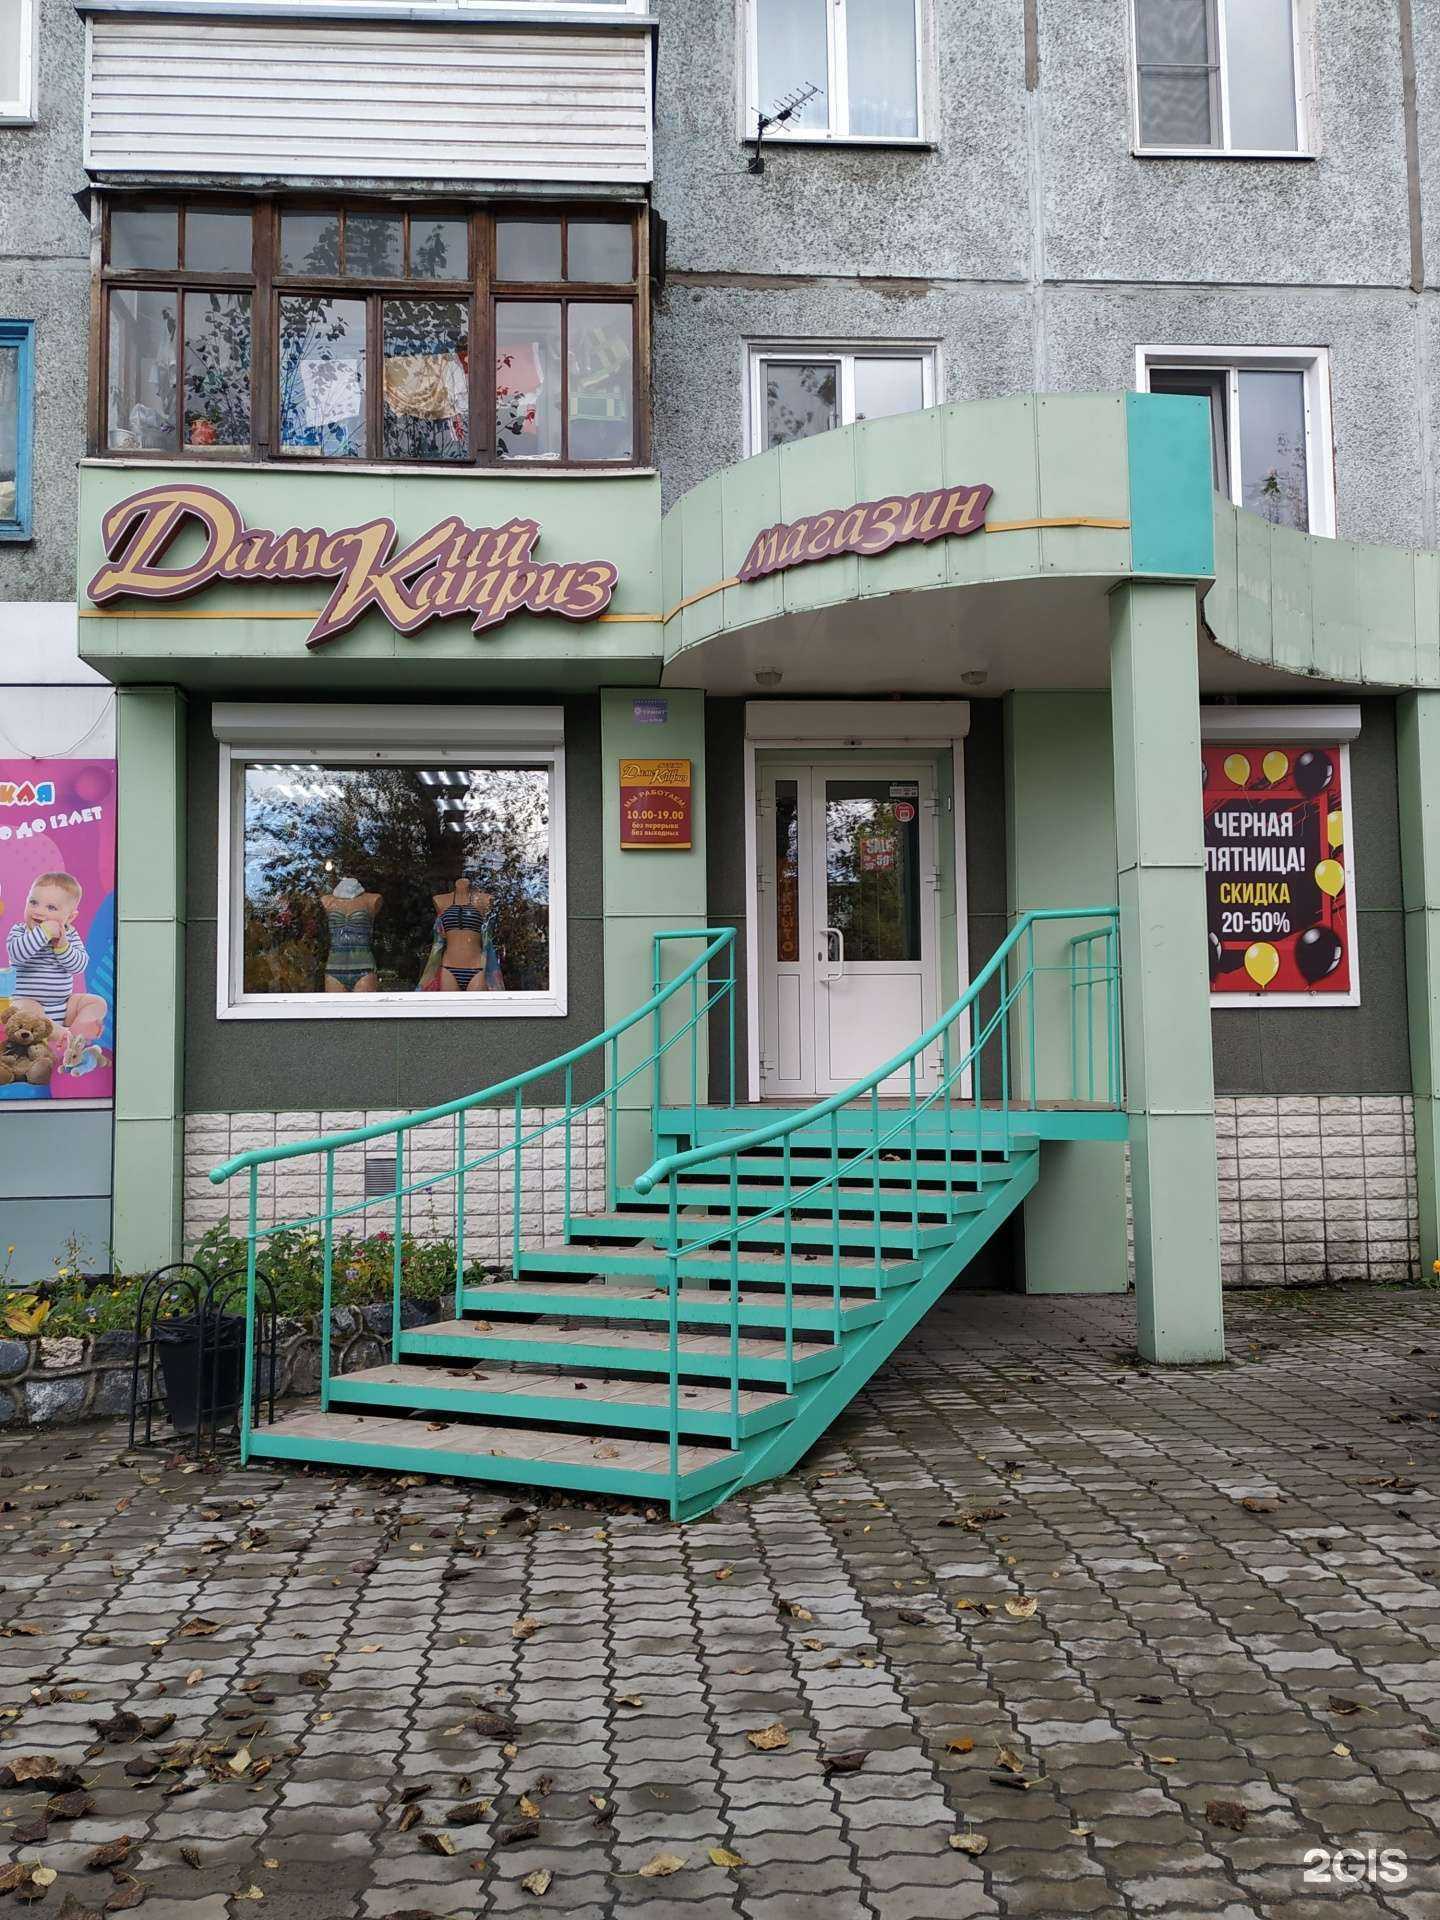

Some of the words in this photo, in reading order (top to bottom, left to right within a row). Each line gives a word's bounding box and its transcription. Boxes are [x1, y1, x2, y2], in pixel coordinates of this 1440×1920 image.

[742, 487, 985, 575] магазин
[627, 810, 685, 820] 10.00-19.00
[1214, 811, 1294, 838] ЧЕРНАЯ
[16, 818, 47, 839] ДО
[1203, 846, 1306, 875] ПЯТНИЦА!
[1219, 882, 1291, 907] СКИДКА
[1221, 911, 1291, 934] 20-50%
